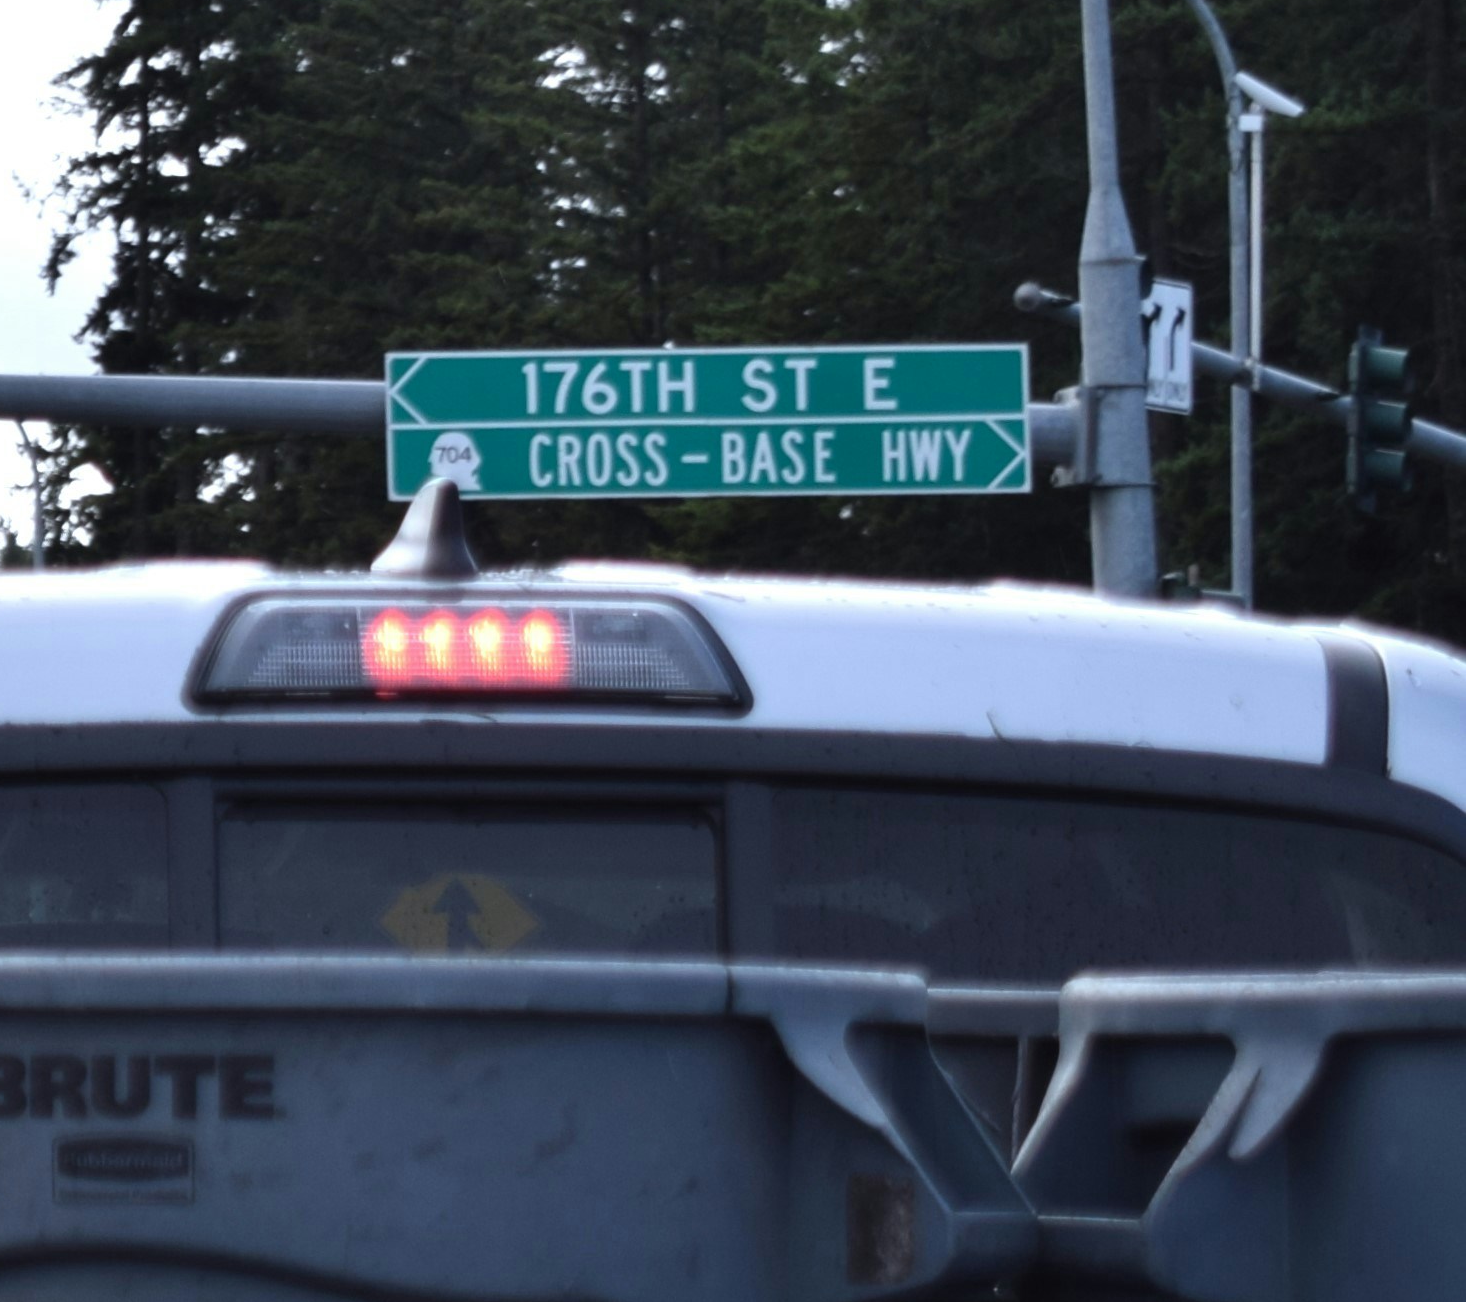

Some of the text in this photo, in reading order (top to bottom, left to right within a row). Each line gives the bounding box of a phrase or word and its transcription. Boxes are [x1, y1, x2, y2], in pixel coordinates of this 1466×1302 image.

[521, 357, 898, 415] 176TH ST E
[434, 446, 472, 463] 704
[881, 429, 972, 482] HWY
